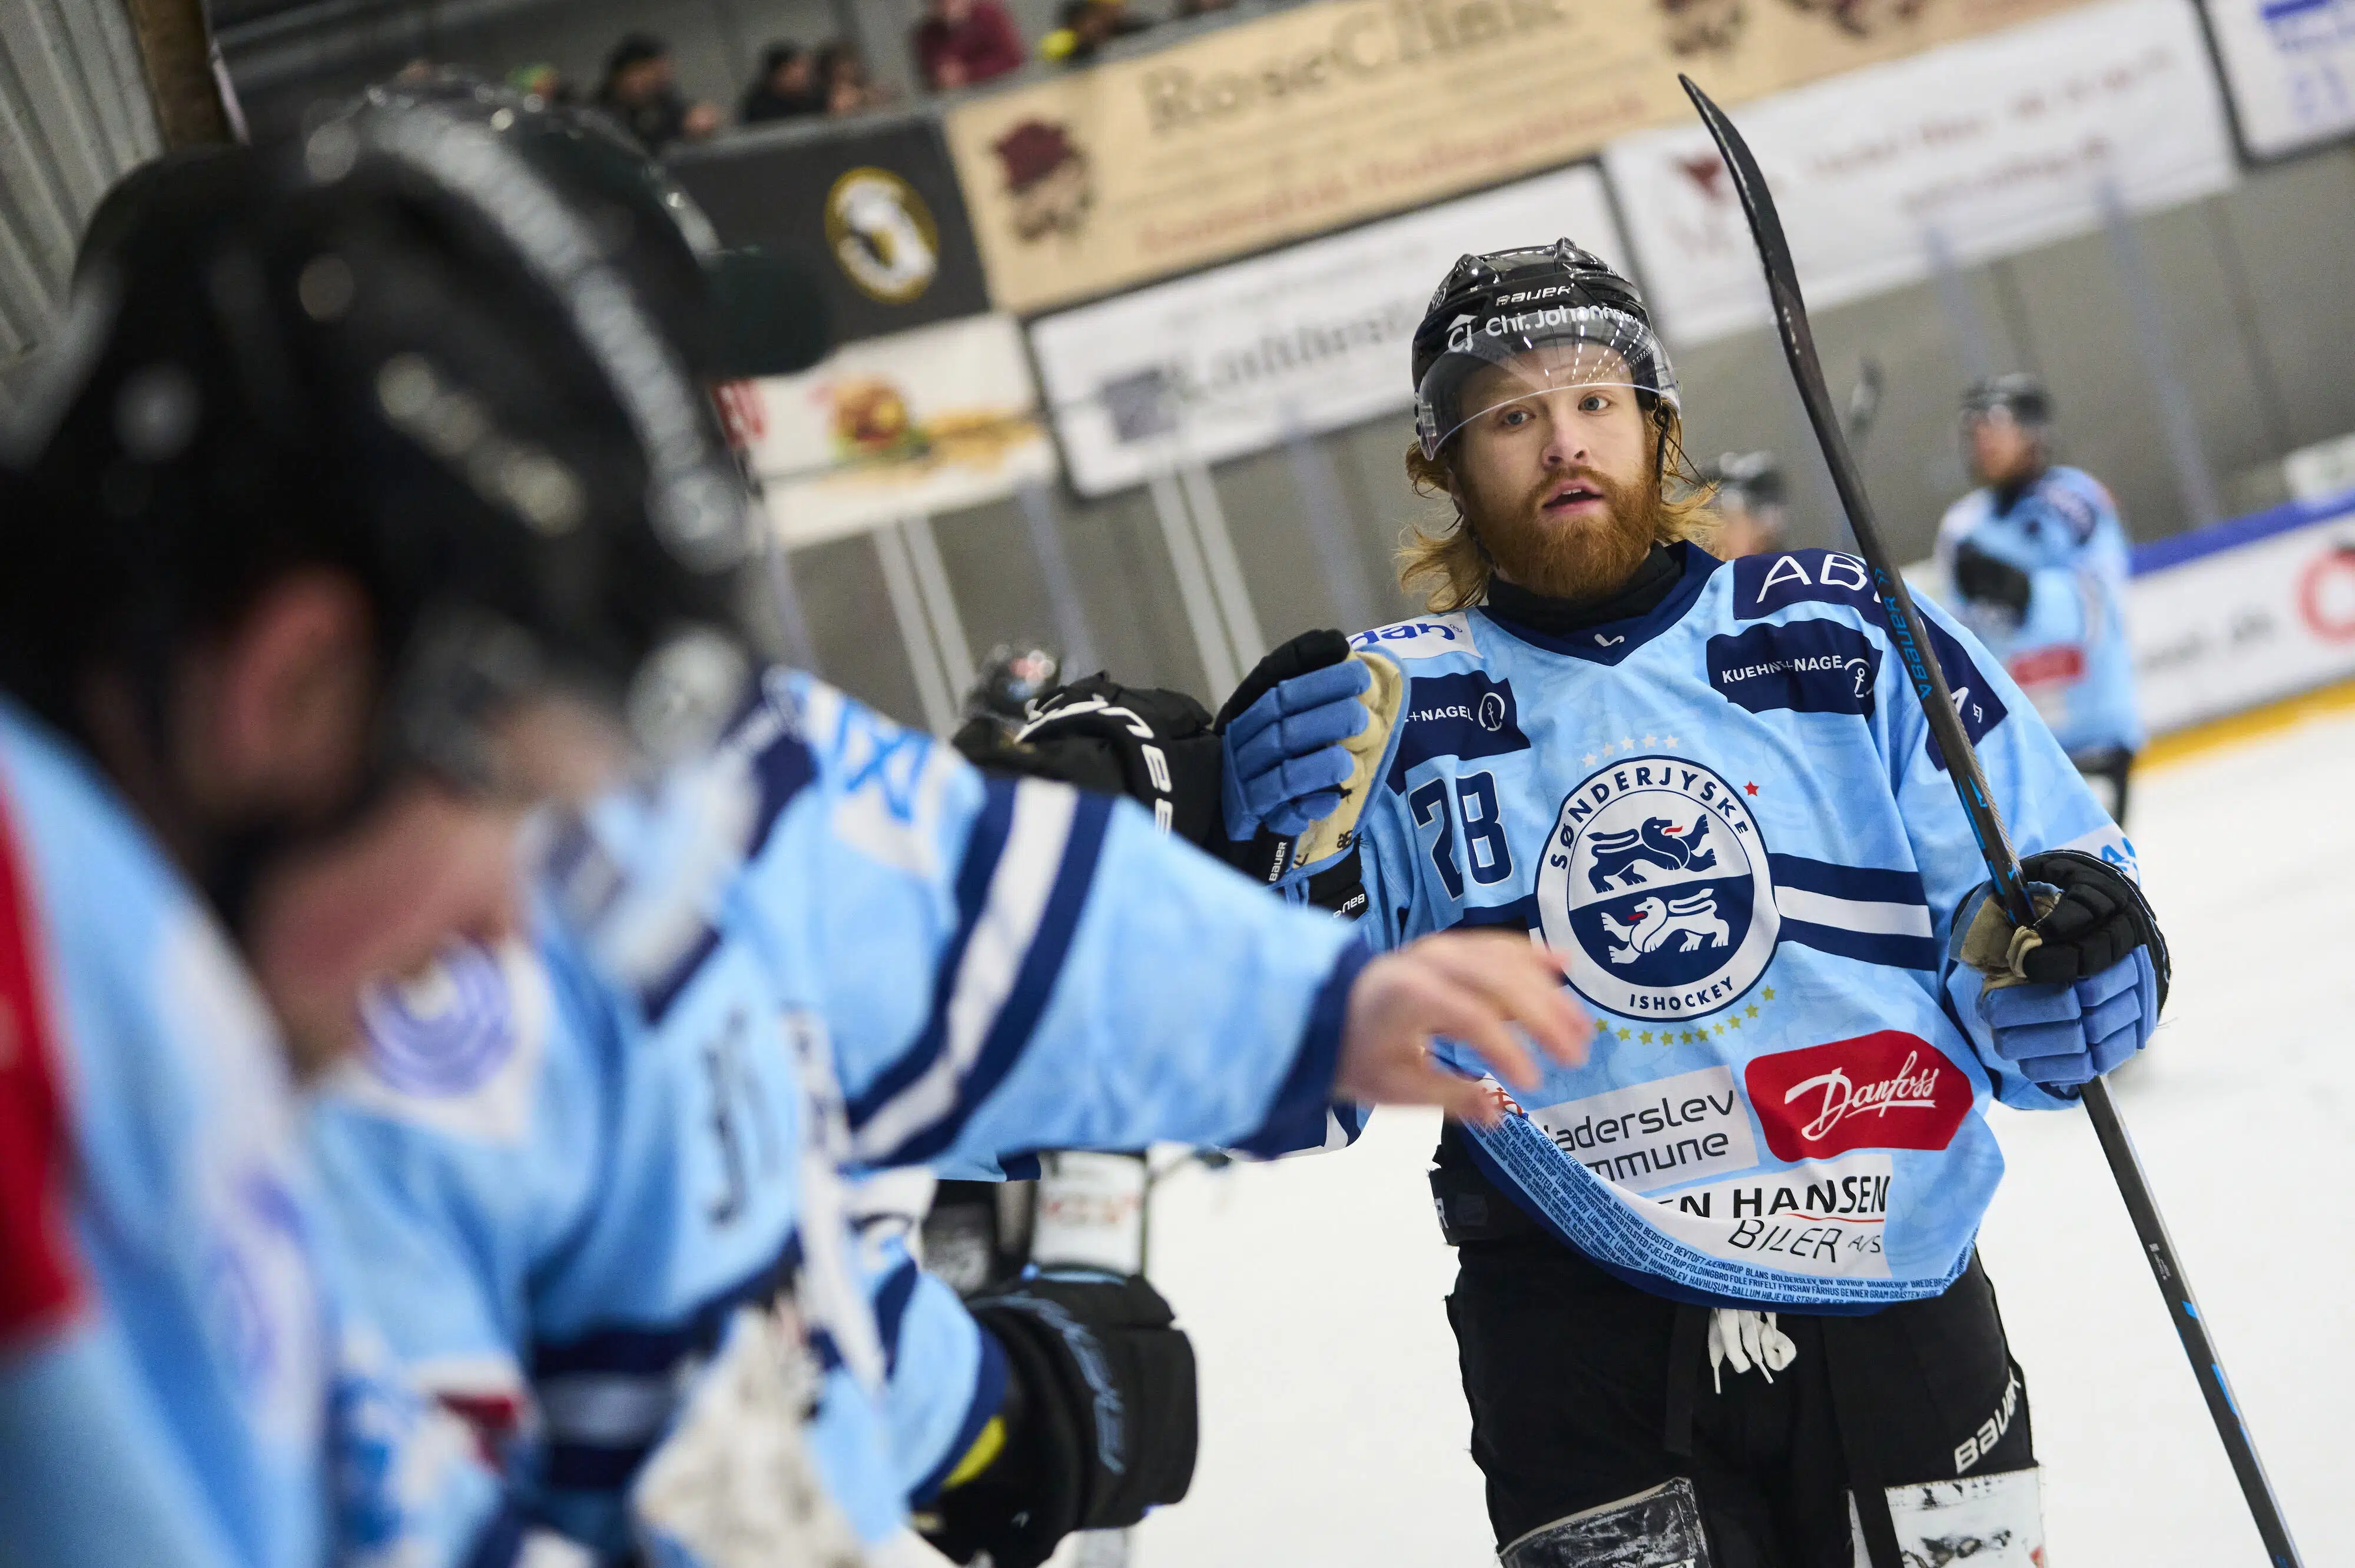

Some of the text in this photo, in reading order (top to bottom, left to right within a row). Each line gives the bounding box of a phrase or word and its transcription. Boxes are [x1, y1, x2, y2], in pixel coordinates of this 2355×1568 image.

[1757, 553, 1881, 603] AB
[1404, 706, 1474, 723] +NAGEL
[1550, 766, 1747, 870] SØNDERJYSKE
[1269, 842, 1288, 882] BAUER
[1629, 976, 1734, 1011] ISHOCKEY
[1784, 1050, 1940, 1141] Danfoss
[1510, 1140, 1533, 1168] PADBORG
[1531, 1163, 1553, 1190] RAVSTED
[1551, 1187, 1573, 1211] REJSBY
[1570, 1208, 1586, 1226] RENS
[1583, 1222, 1597, 1238] RIBE
[1534, 1153, 1557, 1177] LINTRUP
[1555, 1176, 1590, 1214] LUNDERSKOV
[1587, 1212, 1616, 1243] LUNDTOFT
[1614, 1241, 1642, 1267] LUSTRUP
[1733, 1176, 1890, 1218] HANSEN
[1573, 1222, 1590, 1243] BJERT
[1584, 1193, 1621, 1234] HOSTRUPSKOV
[1619, 1229, 1649, 1262] HOVSLUND
[1649, 1257, 1688, 1281] HUNDSLEV
[1613, 1201, 1644, 1230] BALLEBRO
[1643, 1227, 1674, 1250] BEDSTED
[1674, 1245, 1706, 1264] BEVTOFT
[1746, 1268, 1769, 1280] BLANS
[1771, 1274, 1816, 1284] BOLDERSLEV
[1836, 1279, 1864, 1287] BOVRUP
[1867, 1280, 1908, 1289] BRANDERUP
[1623, 1221, 1649, 1247] FELSTED
[1648, 1244, 1687, 1268] FJELSTRUP
[1686, 1264, 1729, 1281] FOLDINGBRO
[1730, 1275, 1747, 1286] FOLE
[1749, 1278, 1777, 1290] FRIFELT
[1778, 1283, 1810, 1294] FYNSHAV
[1812, 1284, 1839, 1295] FÅRHUS
[1840, 1288, 1869, 1298] GENNER
[1869, 1288, 1889, 1298] GRAM
[1728, 1219, 1842, 1263] BILER
